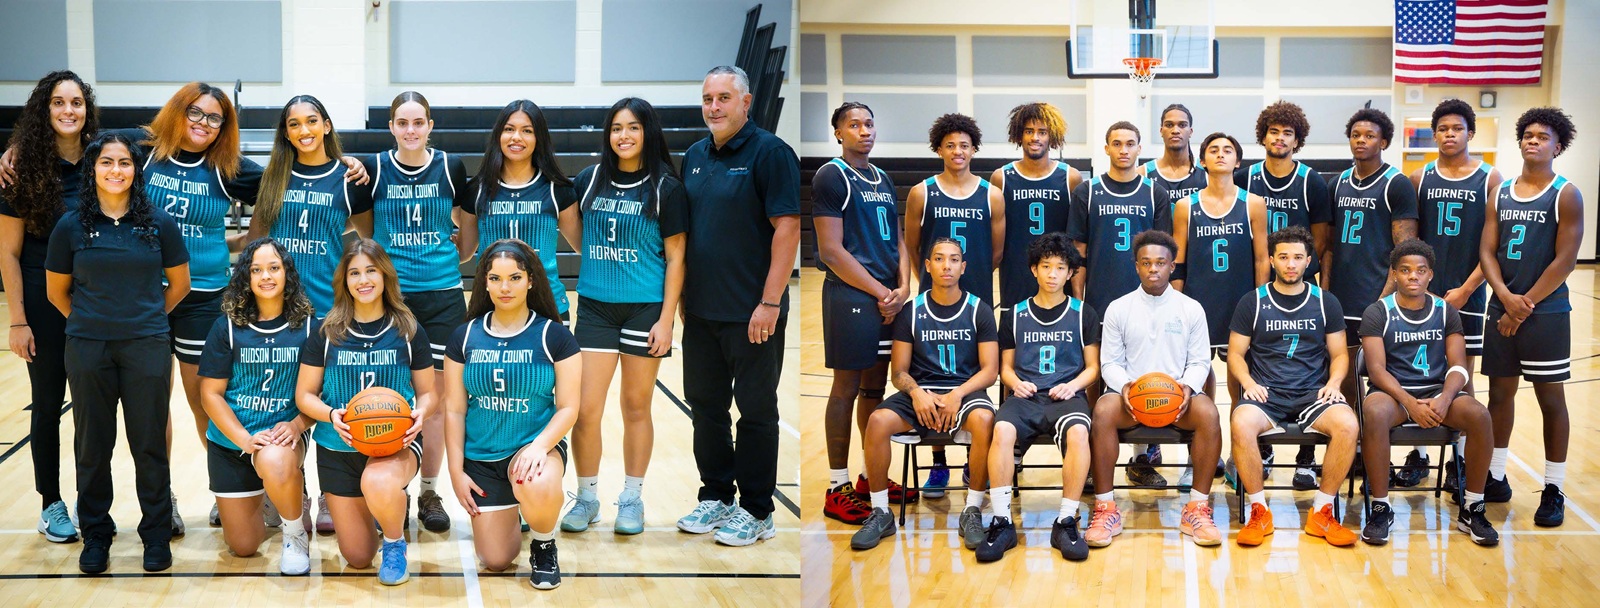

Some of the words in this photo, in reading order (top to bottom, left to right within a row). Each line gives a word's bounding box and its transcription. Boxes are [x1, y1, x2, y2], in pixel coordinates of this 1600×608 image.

[149, 172, 180, 191] HUDSON
[182, 180, 209, 196] COUNTY
[387, 184, 413, 199] HUDSON
[415, 183, 439, 198] COUNTY
[283, 189, 306, 203] UDSON
[307, 191, 334, 207] COUNTY
[1013, 189, 1060, 201] HORNETS
[1263, 196, 1298, 210] ORNETS
[1338, 196, 1376, 209] HORNETS
[1427, 188, 1476, 202] HORNETS
[165, 194, 190, 218] 23
[406, 203, 422, 227] 14
[516, 200, 542, 215] COUNTY
[591, 196, 617, 213] HUDSON
[617, 200, 644, 216] COUNTY
[934, 206, 983, 221] HORNETS
[1099, 204, 1146, 217] HORNETS
[298, 209, 309, 234] 4
[876, 206, 891, 241] 0
[1029, 202, 1045, 236] 9
[1437, 201, 1463, 236] 15
[1500, 209, 1547, 224] HORNETS
[509, 219, 519, 239] 11
[607, 218, 617, 242] 3
[1114, 217, 1131, 251] 3
[1196, 223, 1244, 238] HORNETS
[1341, 209, 1364, 244] 12
[390, 231, 441, 247] HORNETS
[950, 221, 967, 254] 5
[1507, 224, 1526, 260] 2
[589, 245, 638, 263] HORNETS
[1212, 238, 1229, 272] 6
[1265, 318, 1316, 332] HORNETS
[921, 329, 971, 342] HORNETS
[1024, 330, 1073, 343] HORNETS
[1394, 329, 1443, 343] HORNETS
[240, 347, 270, 363] HUDSON
[272, 346, 300, 363] COUNTY
[1283, 333, 1299, 359] 7
[337, 350, 367, 366] HUDSON
[370, 349, 397, 365] COUNTY
[469, 349, 500, 364] HUDSON
[502, 349, 533, 364] COUNTY
[937, 344, 957, 375] 11
[1038, 345, 1056, 374] 8
[1412, 344, 1430, 377] 4
[261, 368, 274, 391] 2
[360, 371, 376, 392] 12
[493, 368, 506, 392] 5
[1137, 382, 1175, 393] SPALDING
[236, 394, 290, 413] HORNETS
[354, 402, 401, 416] SPALDING
